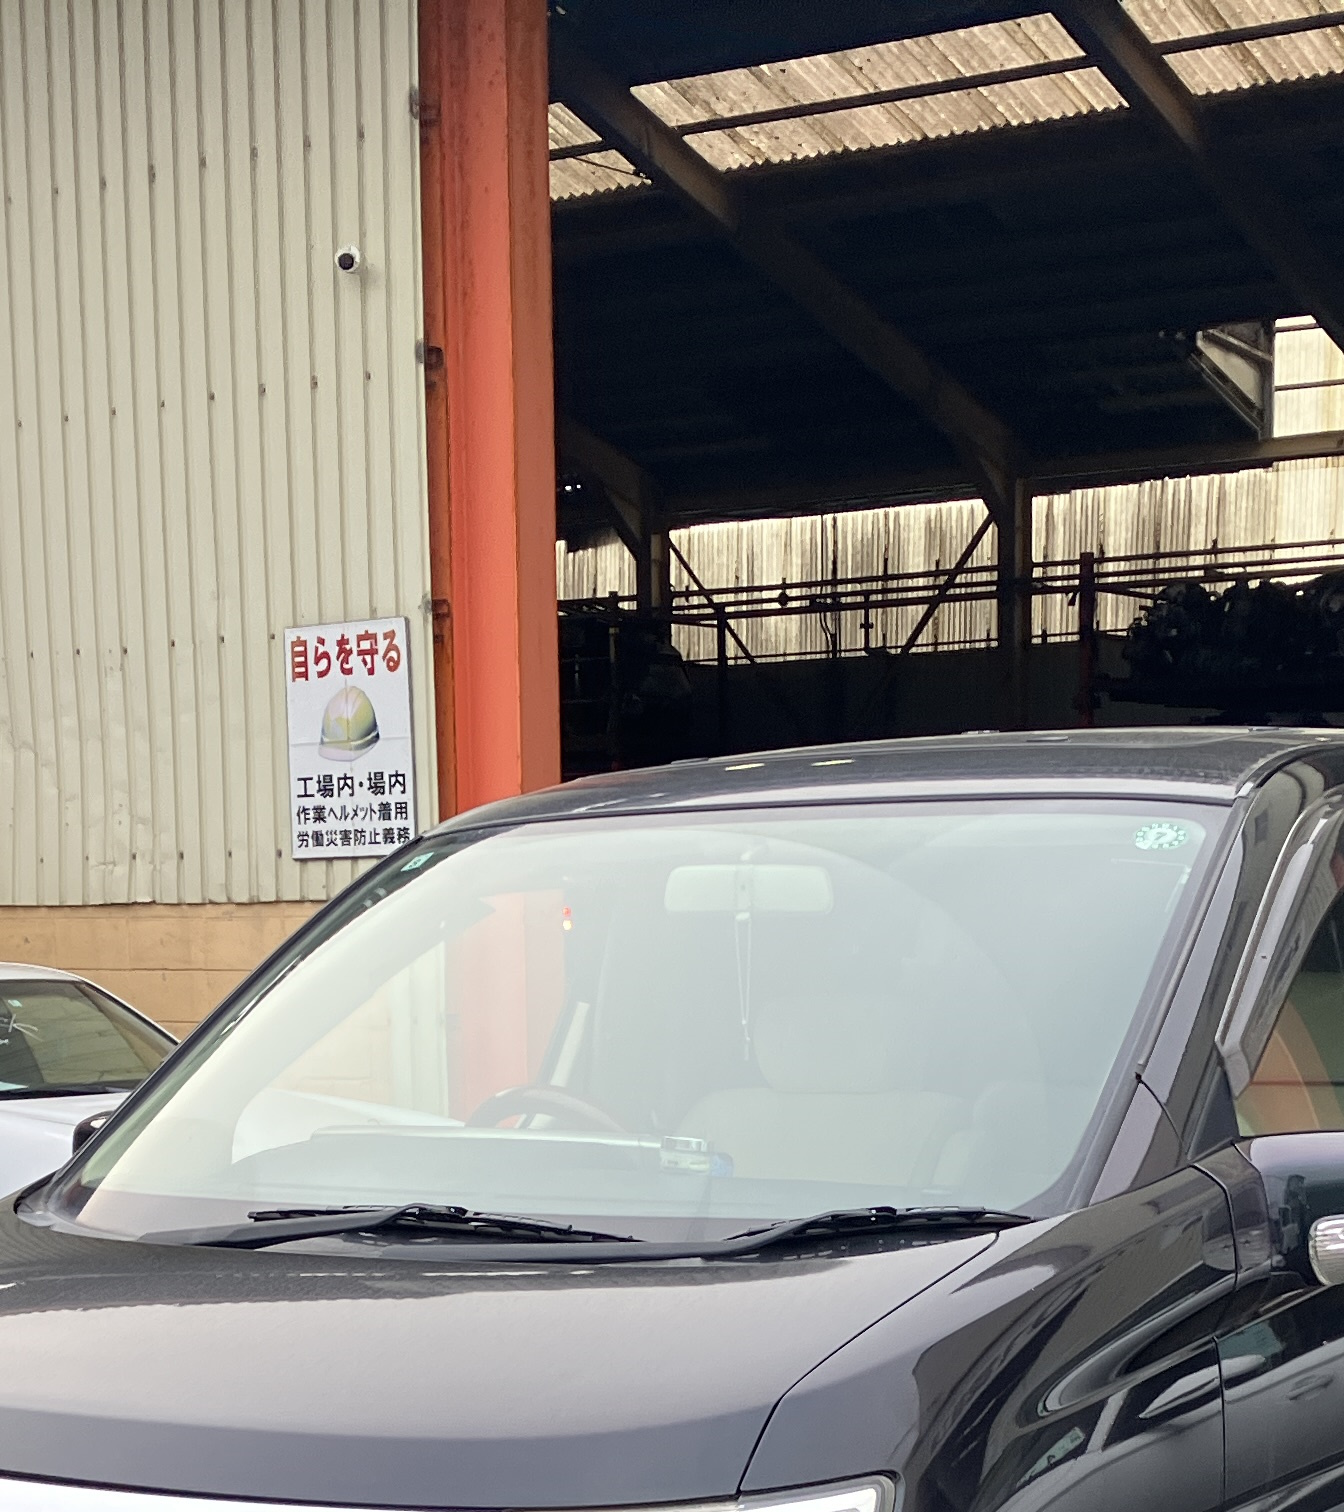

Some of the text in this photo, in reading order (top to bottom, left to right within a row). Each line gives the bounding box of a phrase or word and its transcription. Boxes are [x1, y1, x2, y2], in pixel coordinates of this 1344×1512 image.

[291, 629, 401, 682] 自らを守る
[296, 770, 407, 799] 工場内・場内
[296, 801, 409, 825] 作業ヘルメット着用
[297, 826, 411, 849] 労働災害防止義務
